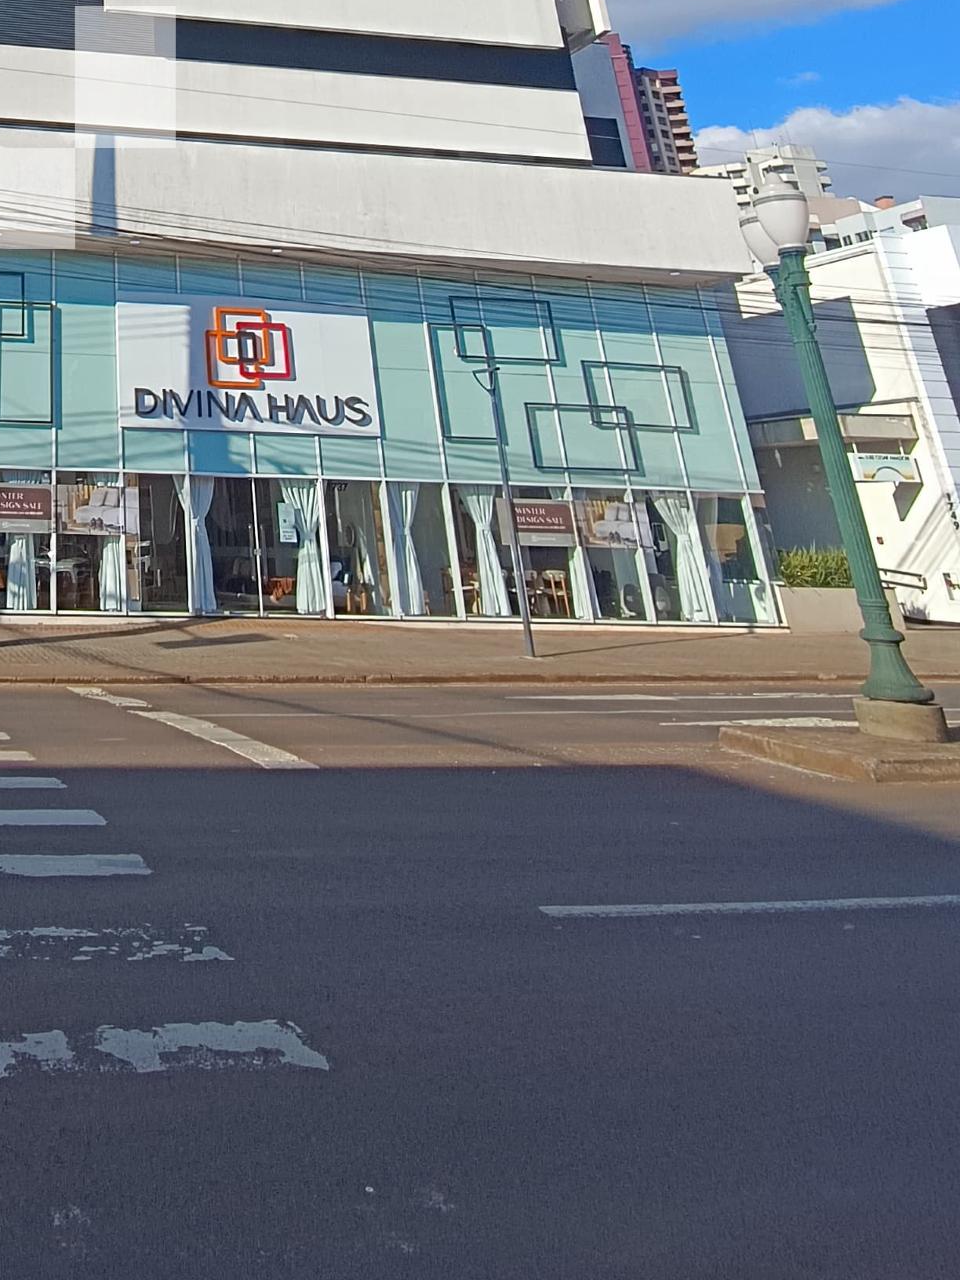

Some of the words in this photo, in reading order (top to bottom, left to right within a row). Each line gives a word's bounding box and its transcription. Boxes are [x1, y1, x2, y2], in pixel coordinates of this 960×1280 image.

[134, 387, 264, 423] DIVINA
[267, 393, 372, 427] HAUS
[22, 501, 42, 510] SALE
[514, 507, 546, 515] WINTER
[945, 492, 960, 531] 1749
[516, 515, 545, 524] DESIGN
[545, 516, 563, 525] SALE
